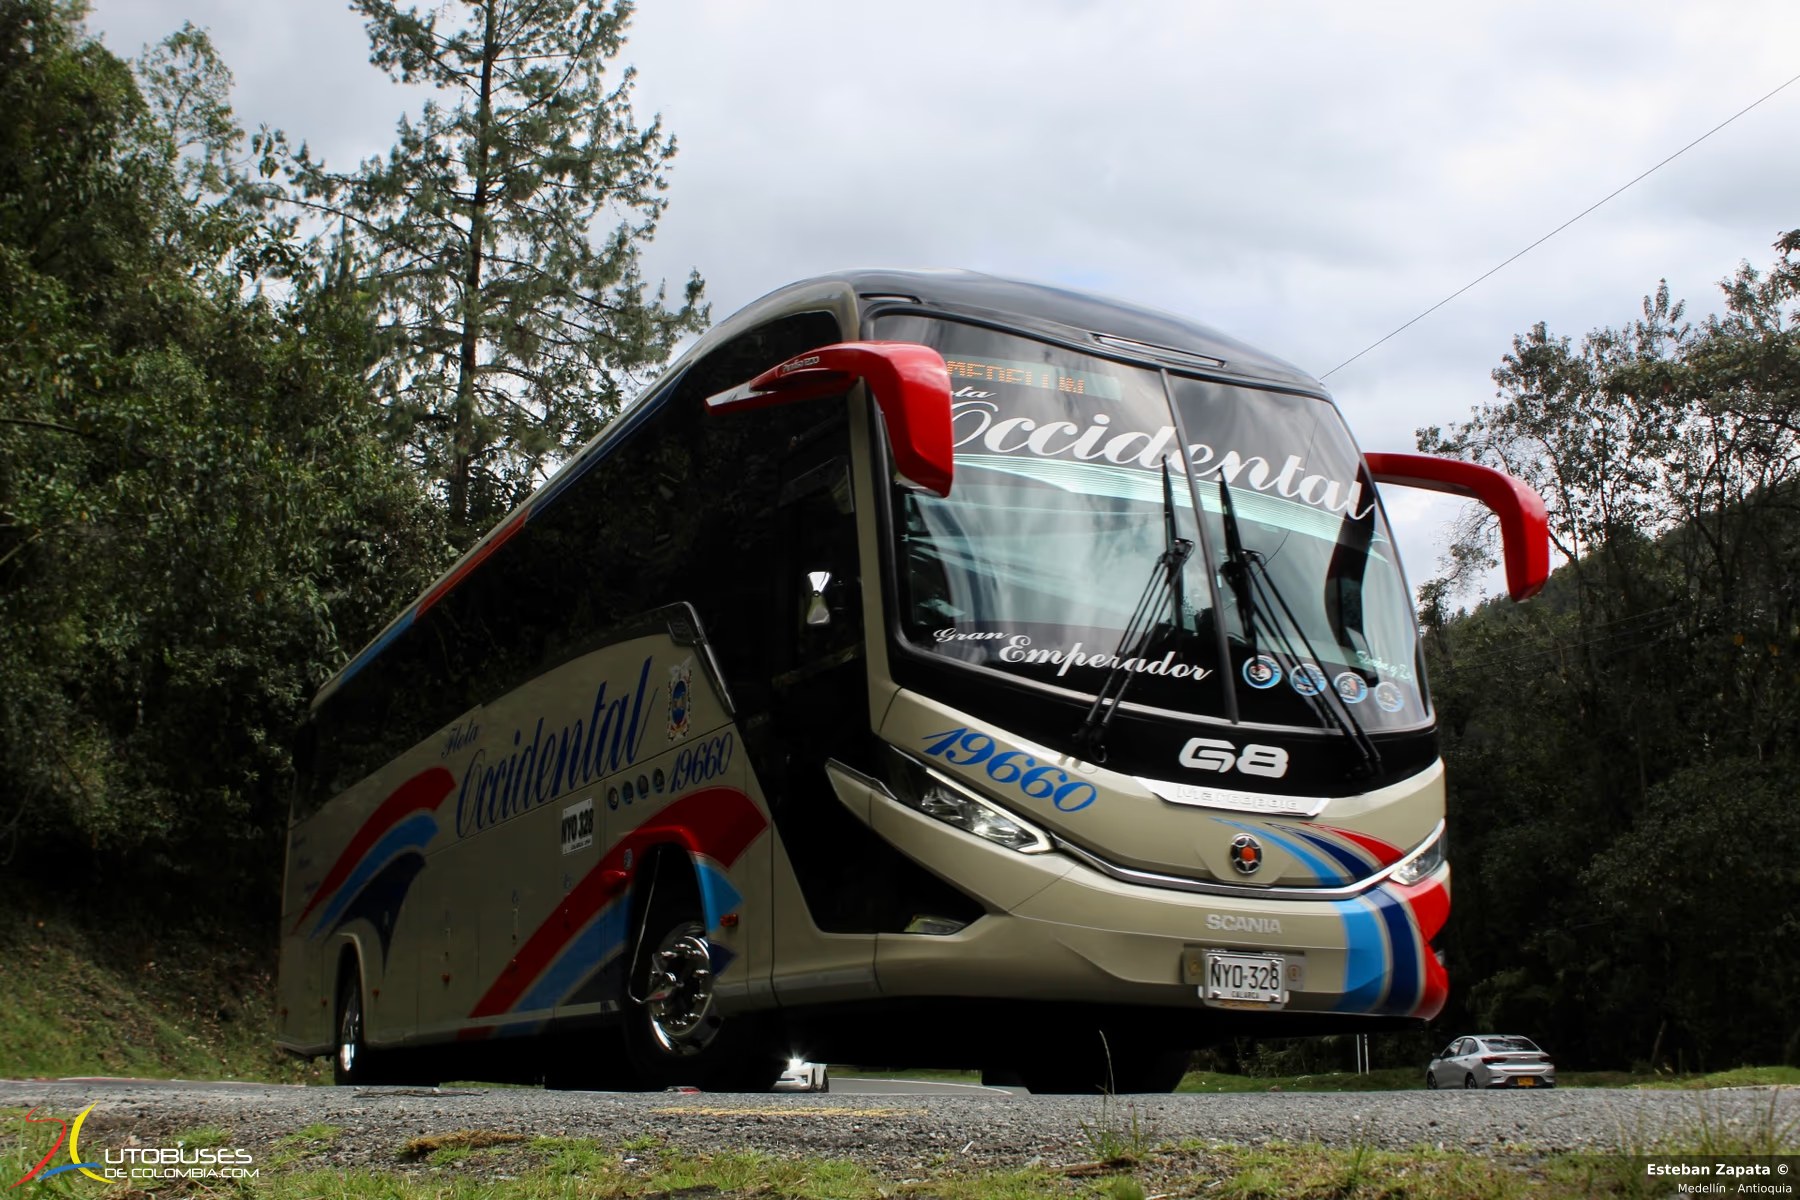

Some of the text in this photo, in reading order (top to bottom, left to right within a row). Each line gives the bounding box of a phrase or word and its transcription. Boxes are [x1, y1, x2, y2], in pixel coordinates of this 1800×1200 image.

[933, 627, 1009, 643] Gran
[999, 635, 1213, 680] Emperador
[456, 656, 658, 838] Occidental
[670, 731, 733, 794] 19660
[1179, 737, 1289, 779] G8
[922, 728, 1097, 812] 19660
[1205, 914, 1282, 934] SCANIA
[1210, 963, 1279, 990] NYO-328
